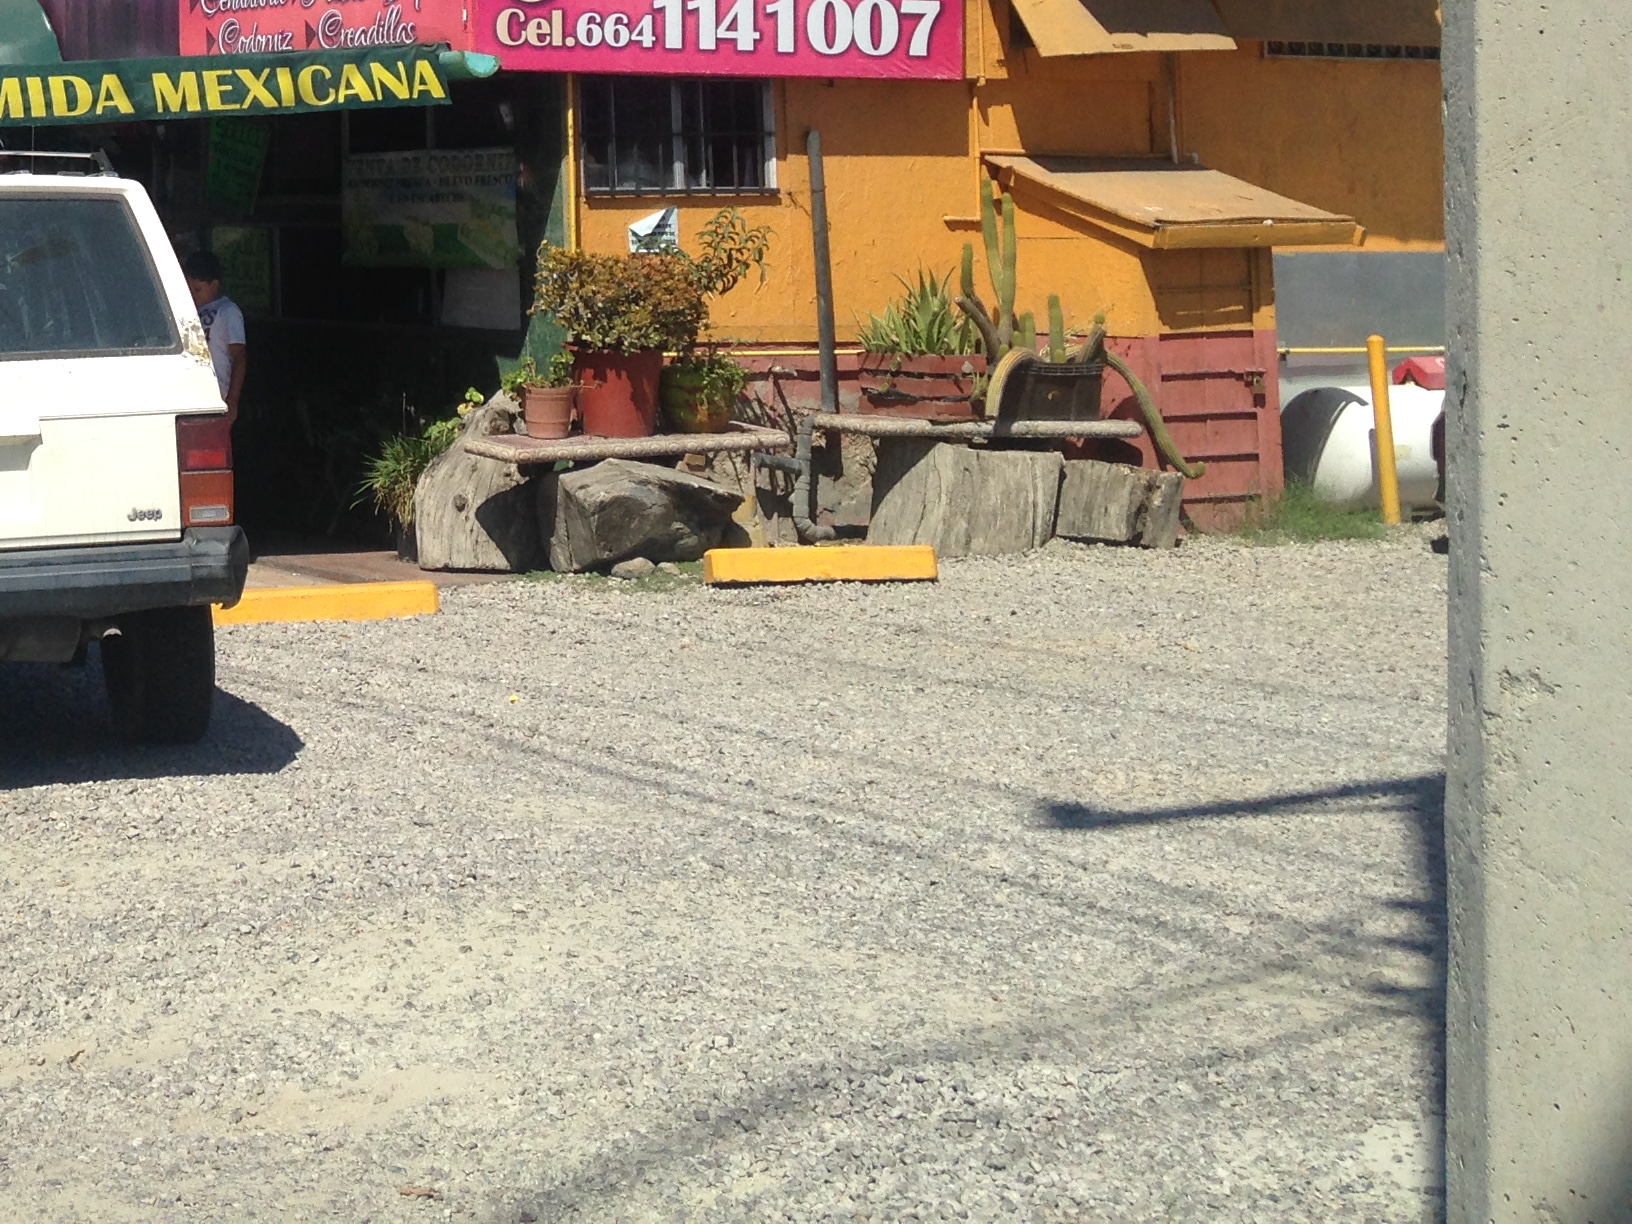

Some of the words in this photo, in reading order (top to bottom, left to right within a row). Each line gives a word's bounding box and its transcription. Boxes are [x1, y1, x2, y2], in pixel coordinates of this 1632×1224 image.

[219, 18, 293, 54] Codorniz
[319, 4, 416, 49] Creadillas
[151, 60, 447, 114] MEXICANA
[126, 507, 163, 522] Jeep
